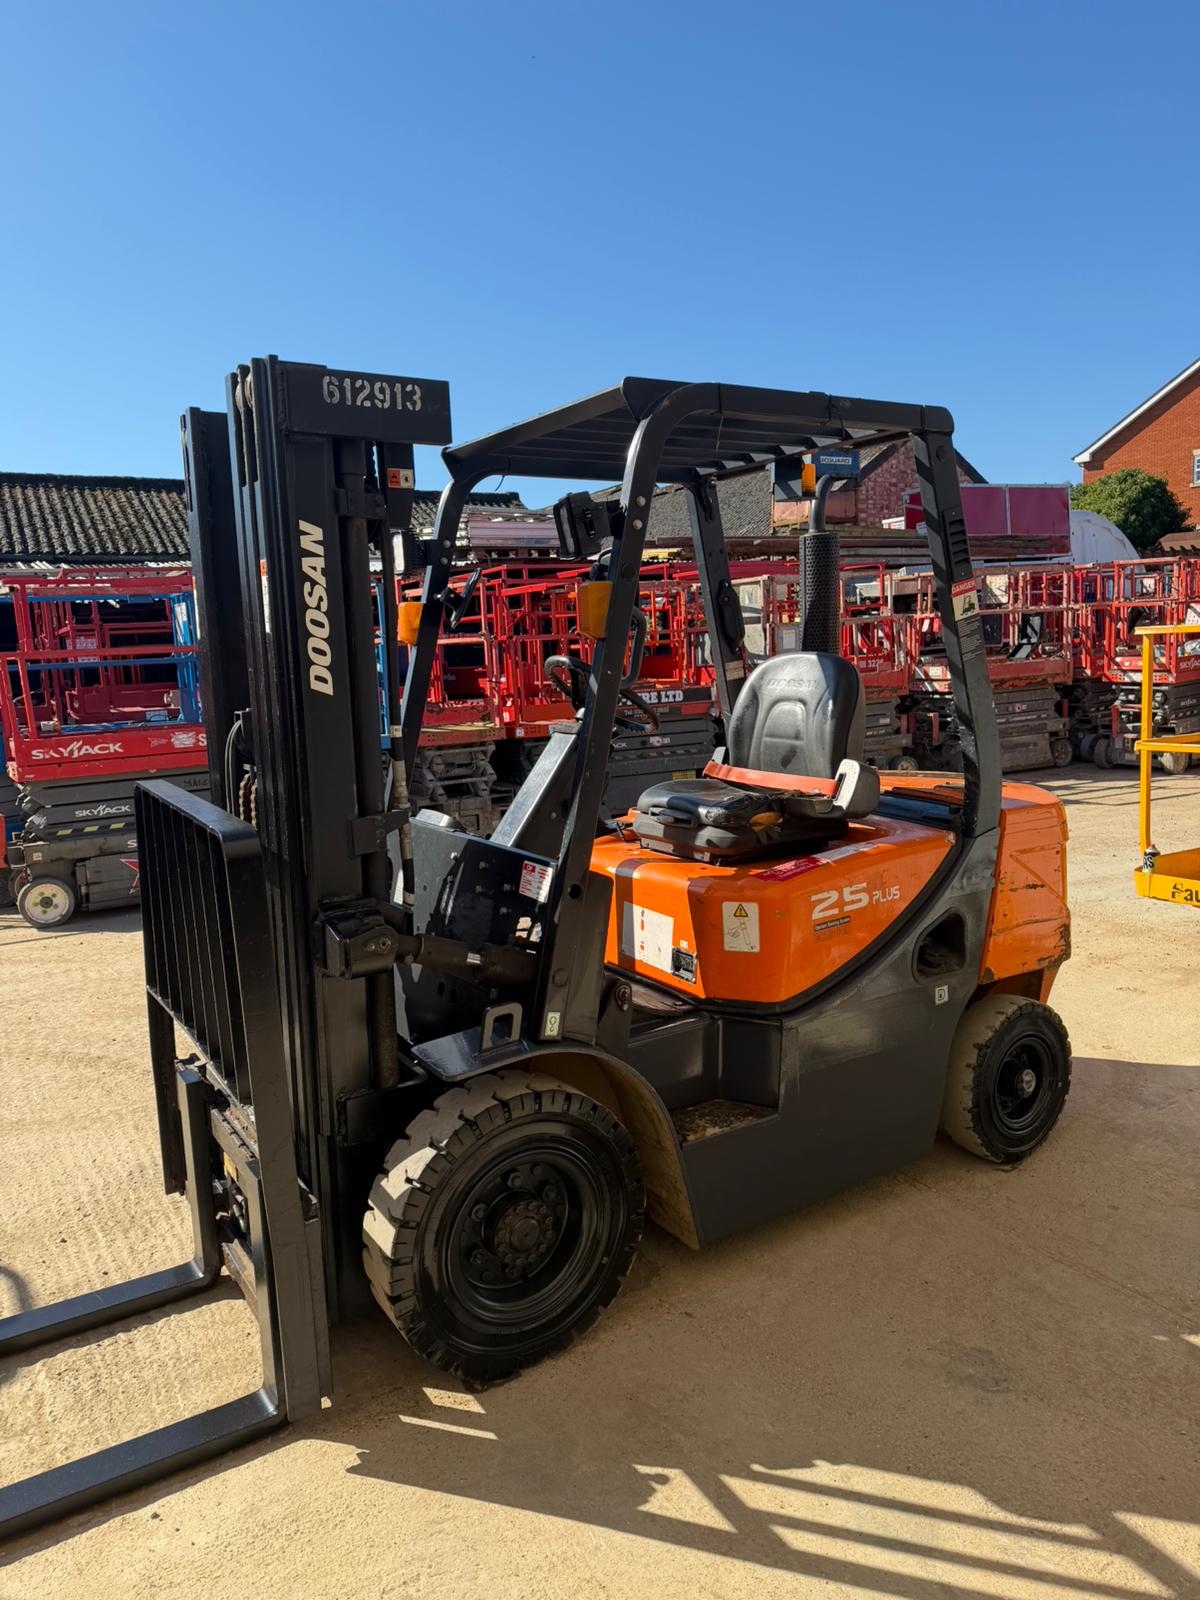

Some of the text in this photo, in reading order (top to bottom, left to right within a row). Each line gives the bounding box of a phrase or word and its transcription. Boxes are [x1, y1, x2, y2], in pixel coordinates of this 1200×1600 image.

[322, 375, 422, 411] 612913
[298, 519, 334, 696] DOOSAN
[660, 690, 684, 703] LTD
[31, 740, 124, 759] SKYJACK
[75, 804, 131, 817] SKYJACK
[811, 882, 900, 920] 25 PLUS
